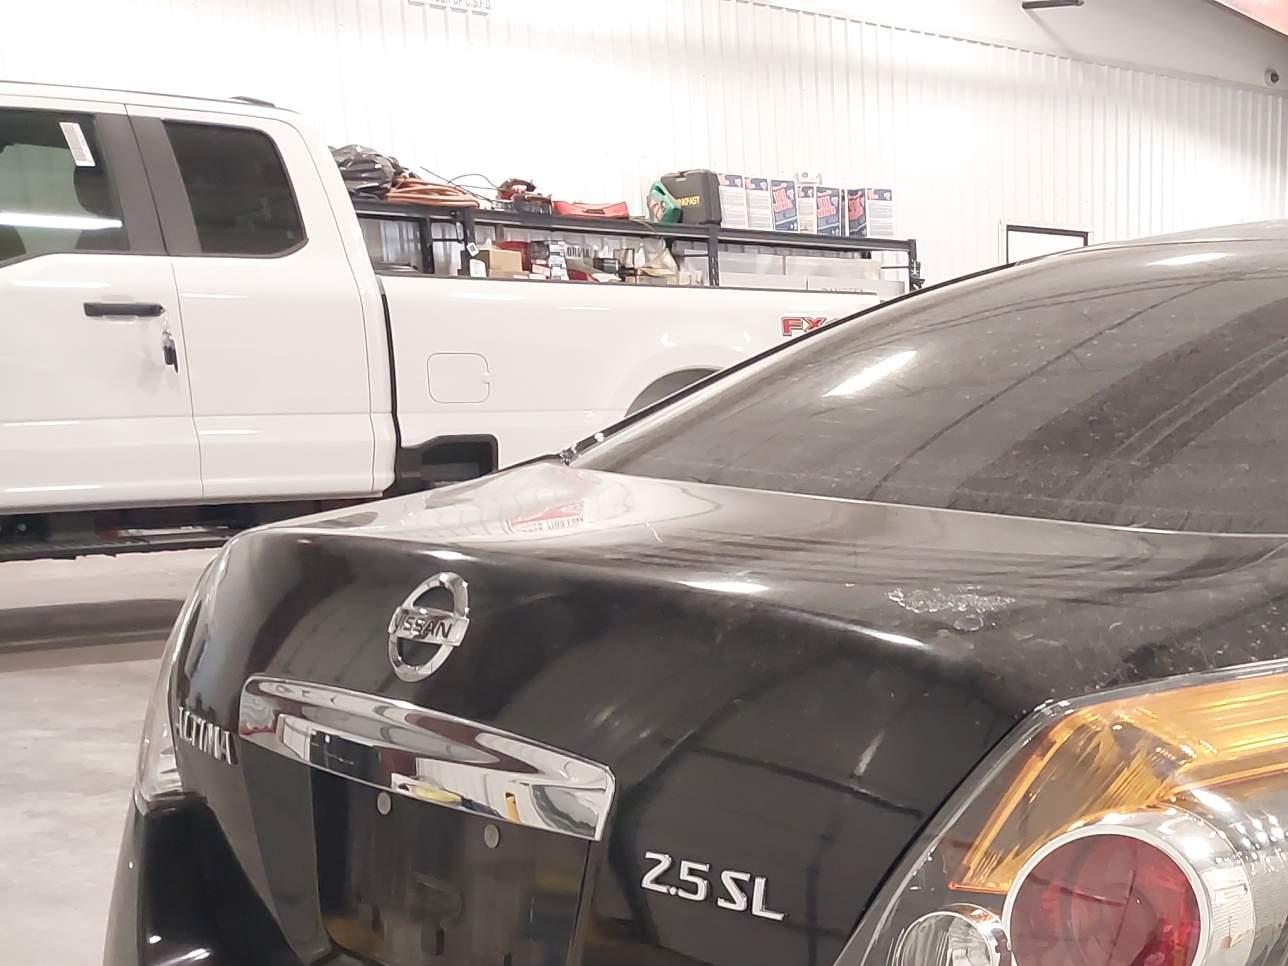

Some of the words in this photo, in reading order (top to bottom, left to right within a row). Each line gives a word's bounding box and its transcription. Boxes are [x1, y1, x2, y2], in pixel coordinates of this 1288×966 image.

[781, 316, 840, 336] FX
[641, 851, 710, 901] 2.5
[717, 870, 784, 920] SL
